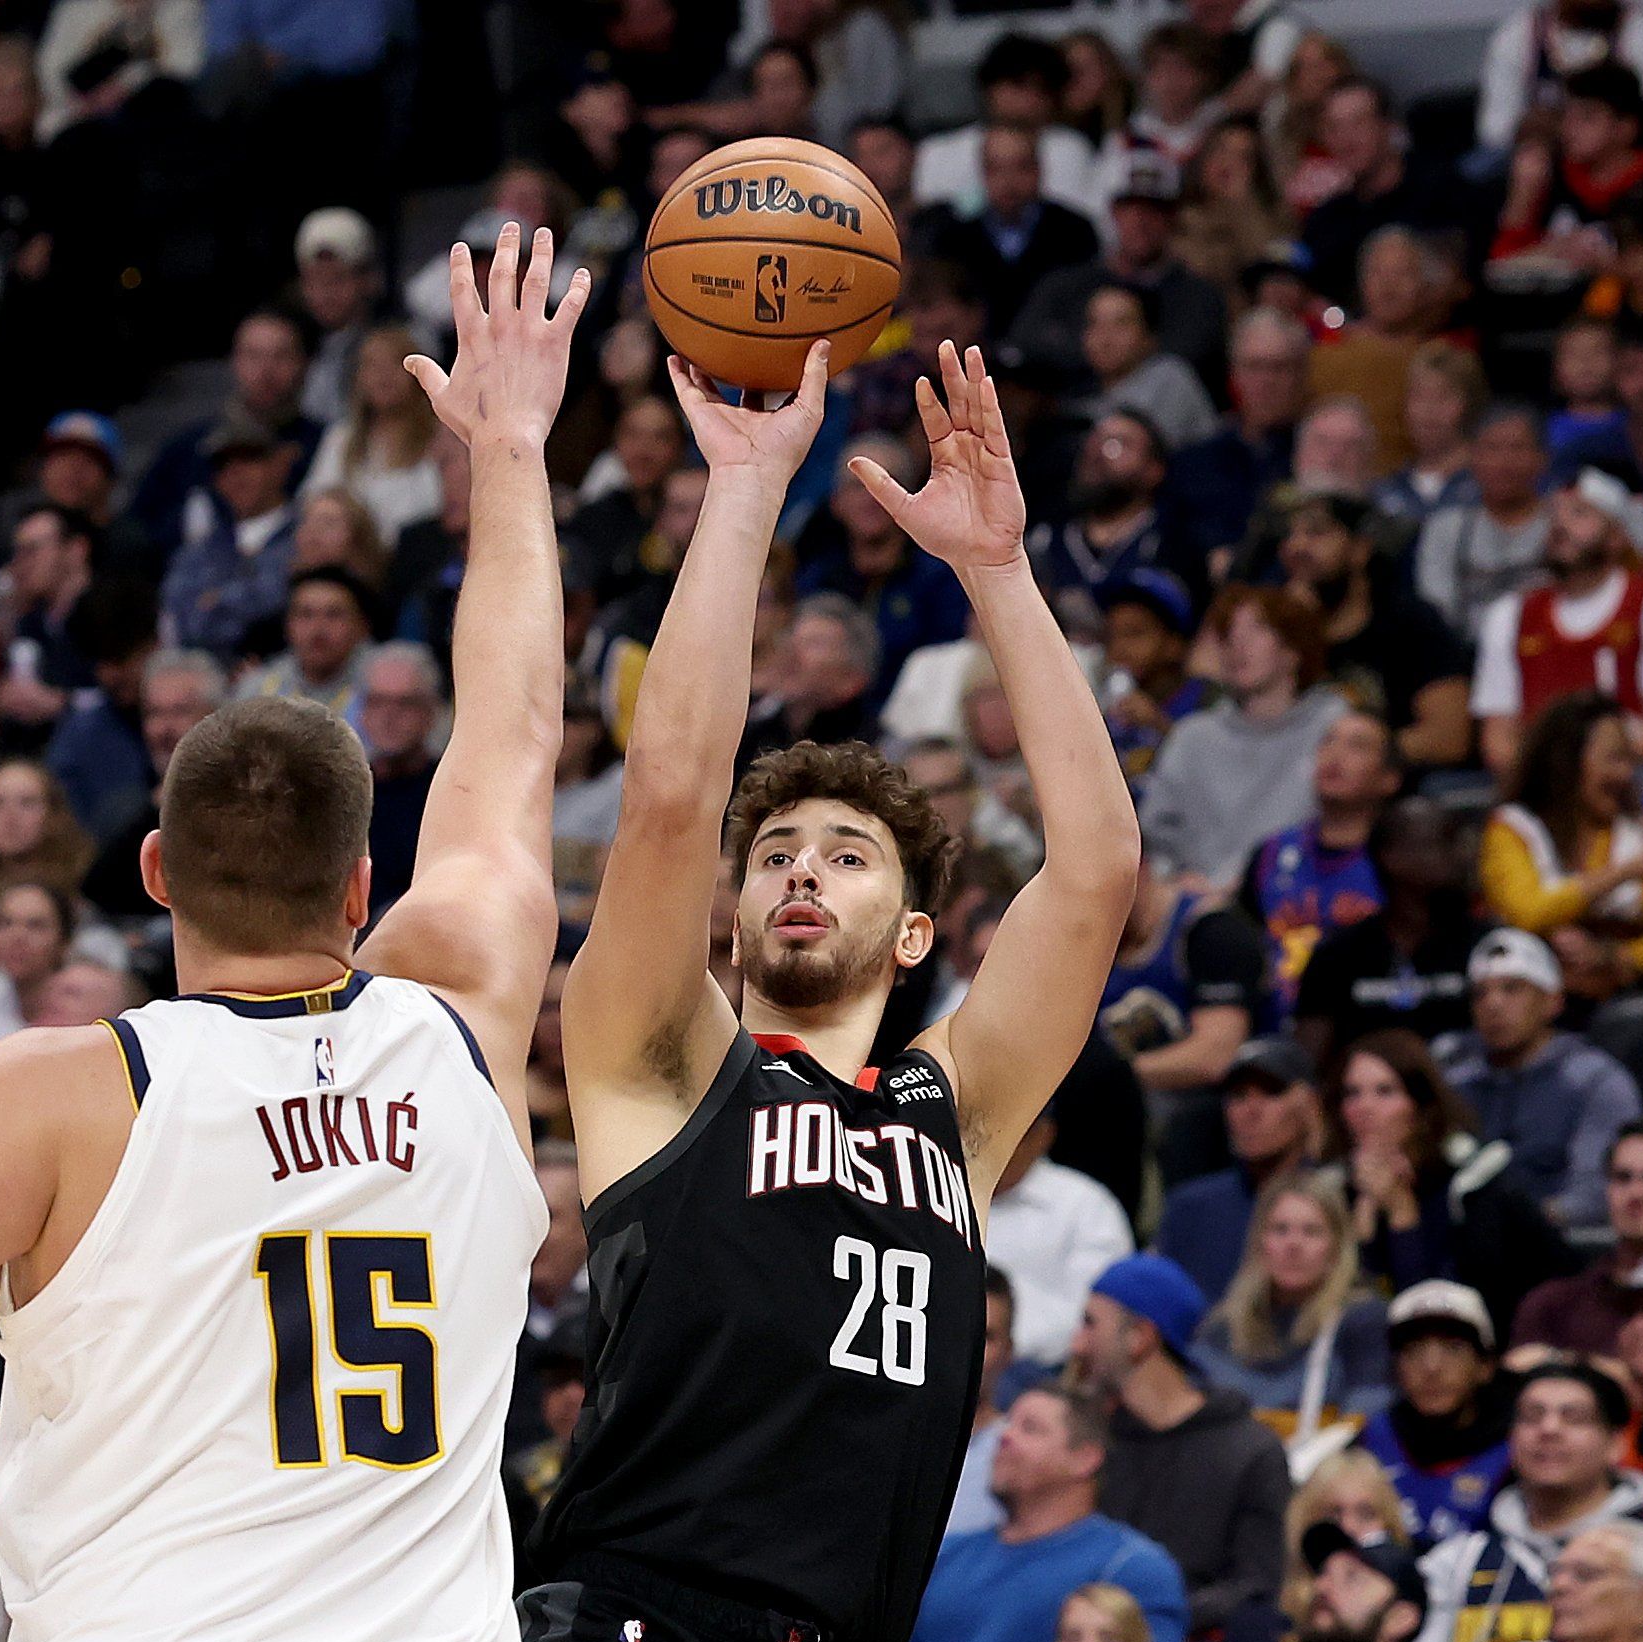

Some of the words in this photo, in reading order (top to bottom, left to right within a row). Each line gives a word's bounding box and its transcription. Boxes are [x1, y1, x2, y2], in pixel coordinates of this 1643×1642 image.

[694, 176, 863, 236] Wilson
[889, 1065, 934, 1089] edit
[894, 1084, 944, 1105] arma
[255, 1091, 417, 1182] JOKIĆ
[747, 1101, 973, 1252] HOUSTON
[253, 1229, 445, 1471] 15
[829, 1234, 931, 1387] 28
